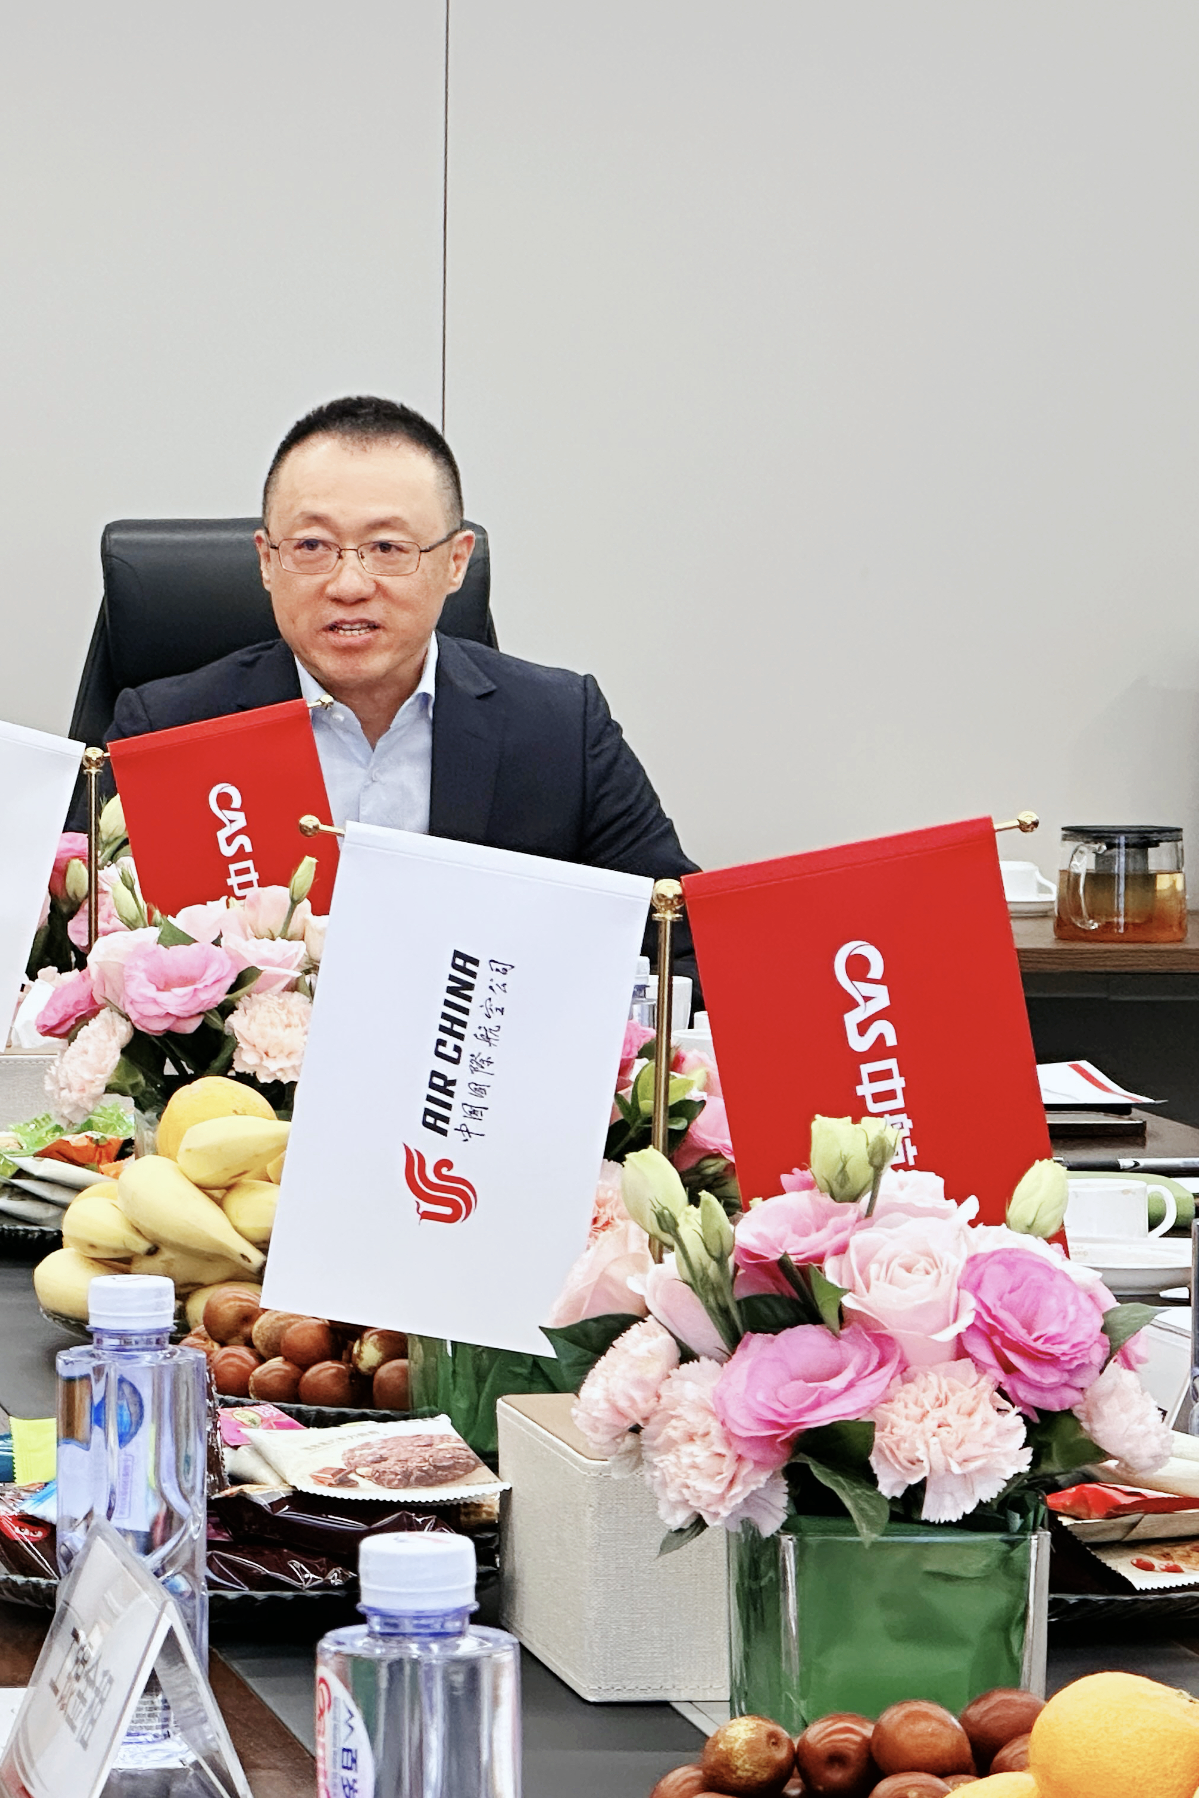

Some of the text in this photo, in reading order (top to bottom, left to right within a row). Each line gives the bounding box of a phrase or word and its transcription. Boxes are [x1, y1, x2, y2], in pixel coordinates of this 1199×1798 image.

[208, 782, 253, 857] CAS
[422, 949, 480, 1137] AIR CHINA
[834, 940, 898, 1052] CAS
